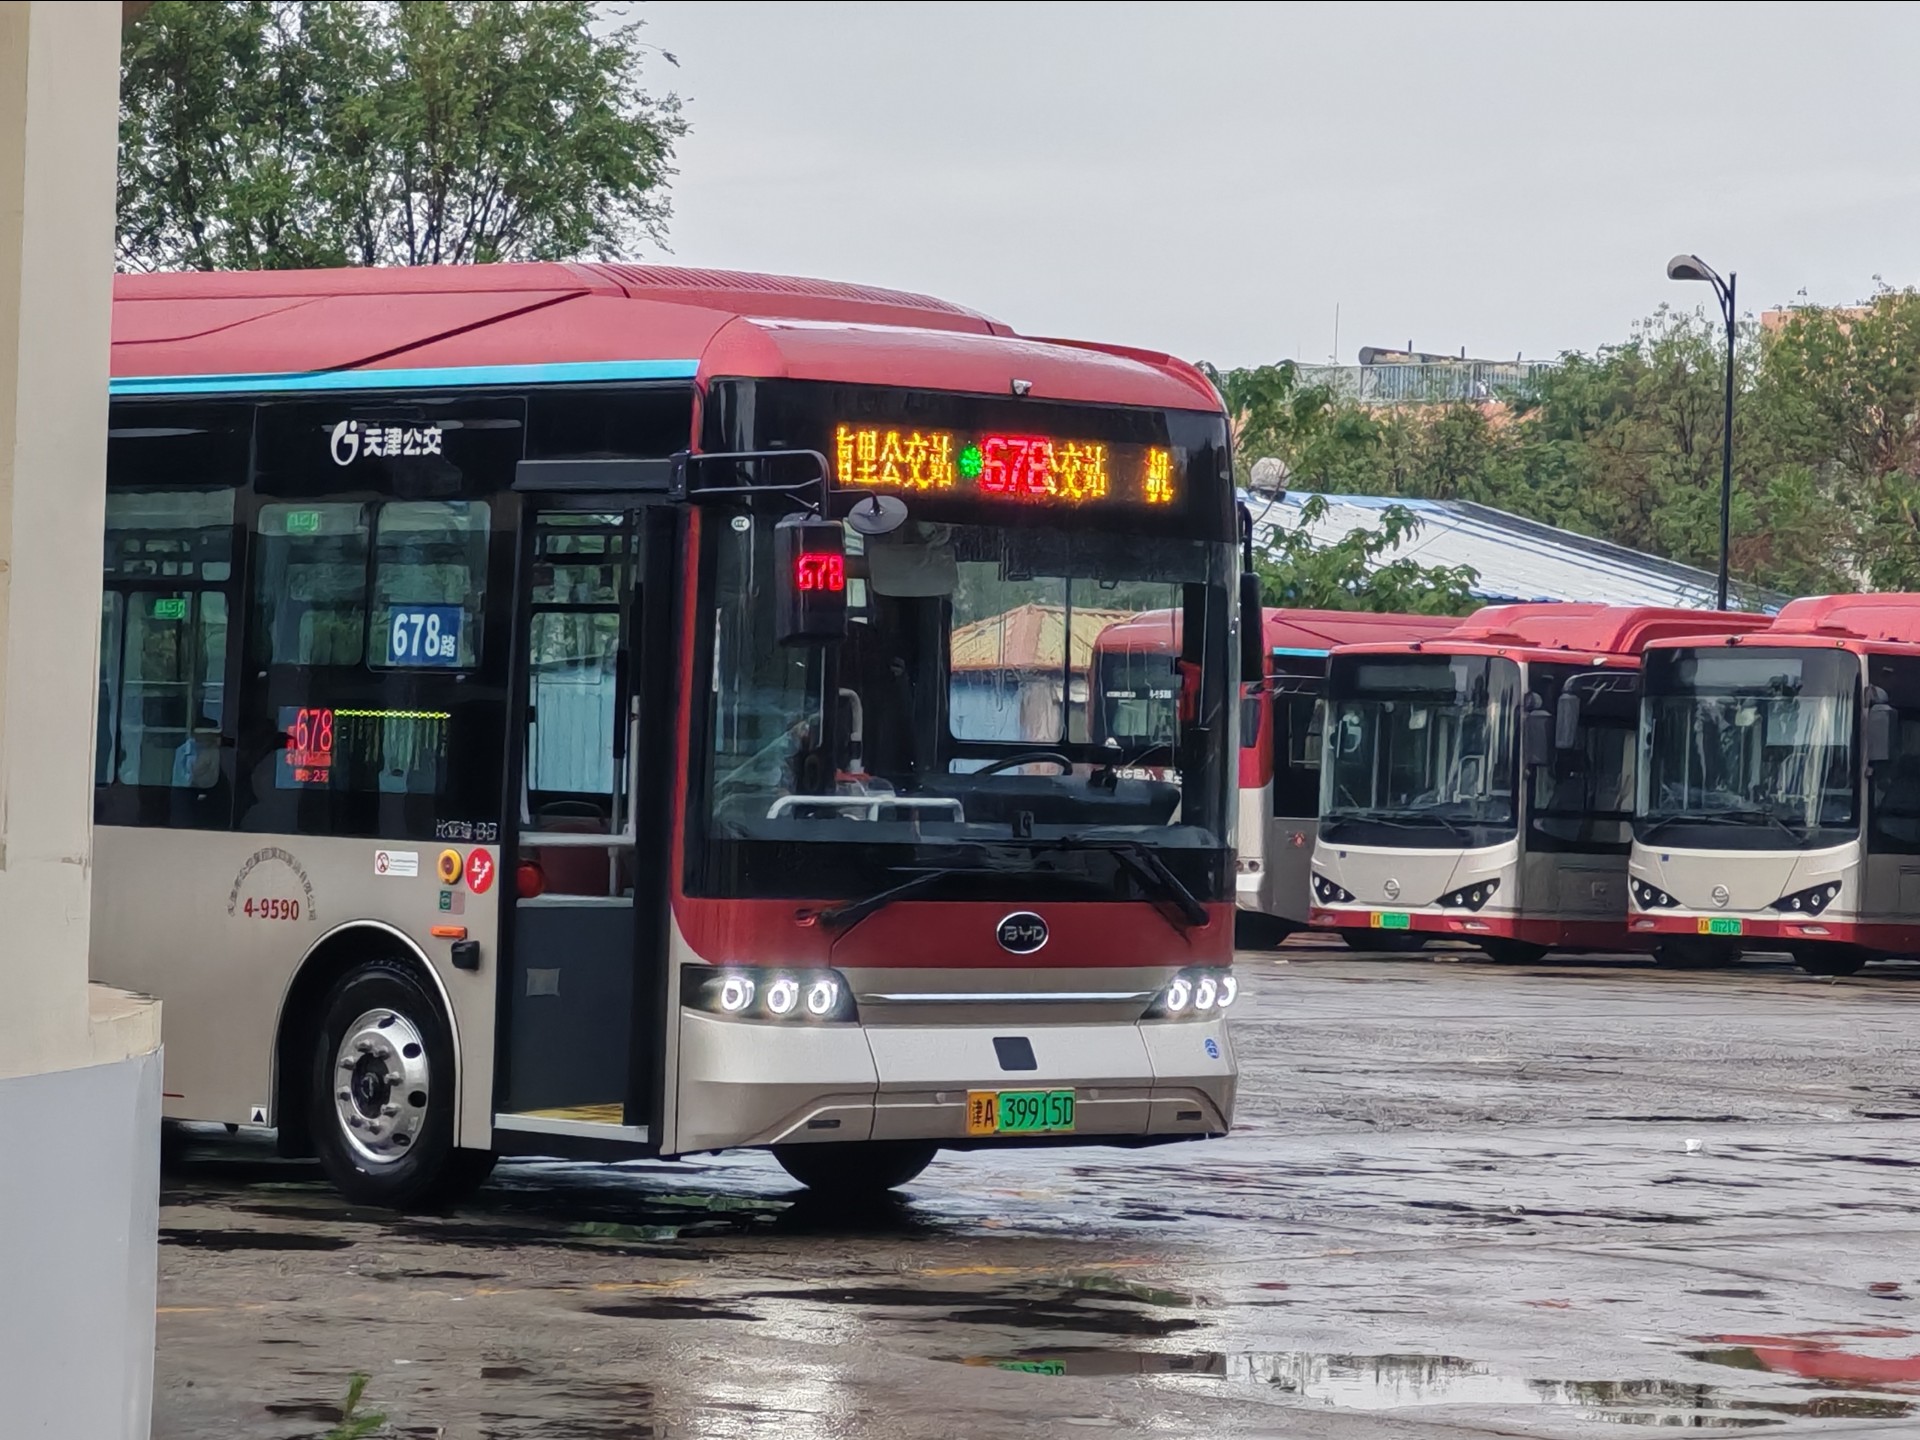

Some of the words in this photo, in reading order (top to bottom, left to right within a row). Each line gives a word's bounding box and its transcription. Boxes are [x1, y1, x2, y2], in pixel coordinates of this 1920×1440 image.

[363, 425, 443, 457] 天津公交
[982, 437, 1049, 493] 678
[798, 554, 844, 591] 678
[296, 708, 333, 751] 678
[244, 897, 300, 921] 4-9590
[1003, 925, 1045, 942] BYD
